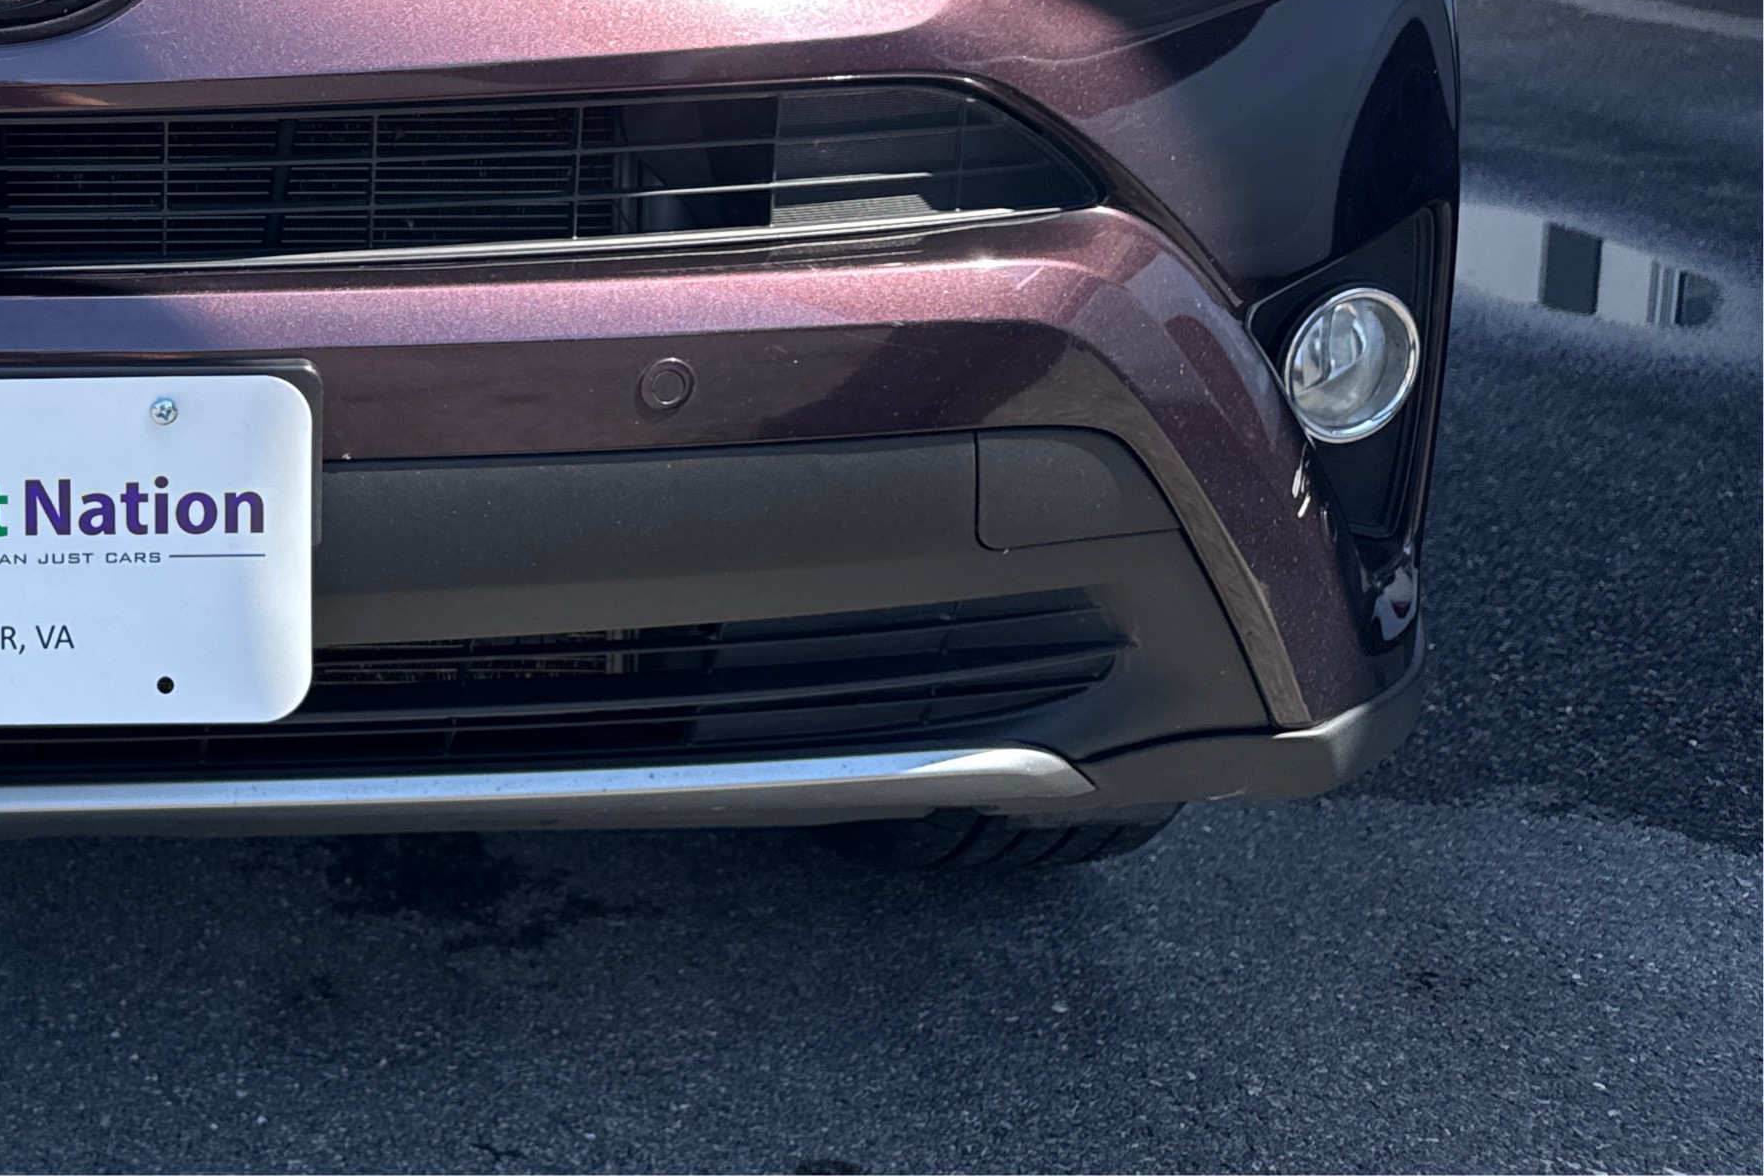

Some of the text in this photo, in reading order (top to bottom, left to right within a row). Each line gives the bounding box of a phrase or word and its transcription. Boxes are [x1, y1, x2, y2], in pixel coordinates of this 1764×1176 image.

[24, 475, 265, 537] Nation
[37, 552, 94, 565] JUST
[105, 551, 161, 564] CARS
[35, 624, 75, 650] VA
